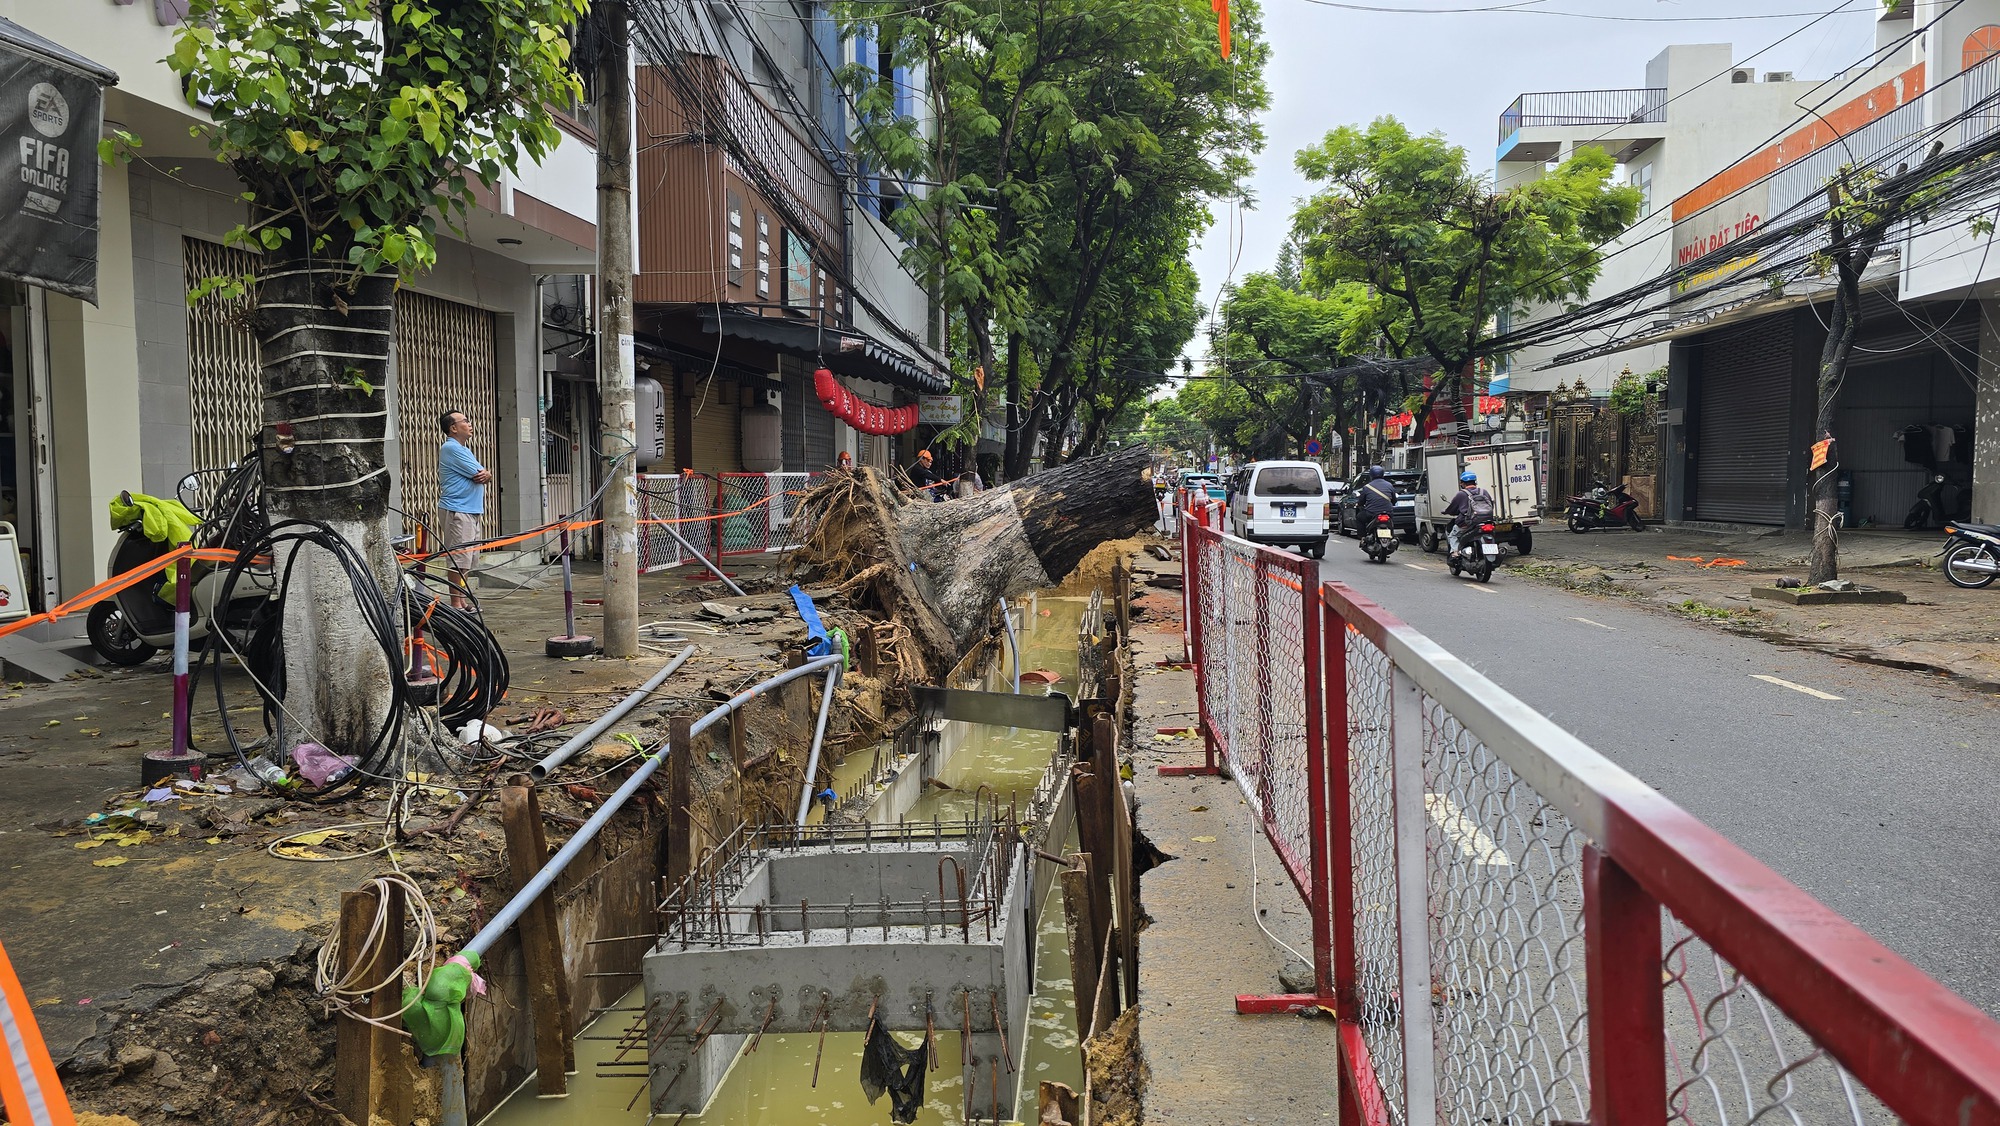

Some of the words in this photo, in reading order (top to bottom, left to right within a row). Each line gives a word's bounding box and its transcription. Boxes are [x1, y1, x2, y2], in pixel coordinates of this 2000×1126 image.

[32, 109, 64, 127] SPORTS
[35, 93, 63, 117] EA
[19, 135, 70, 178] FIFA
[1679, 236, 1706, 266] NHÂN
